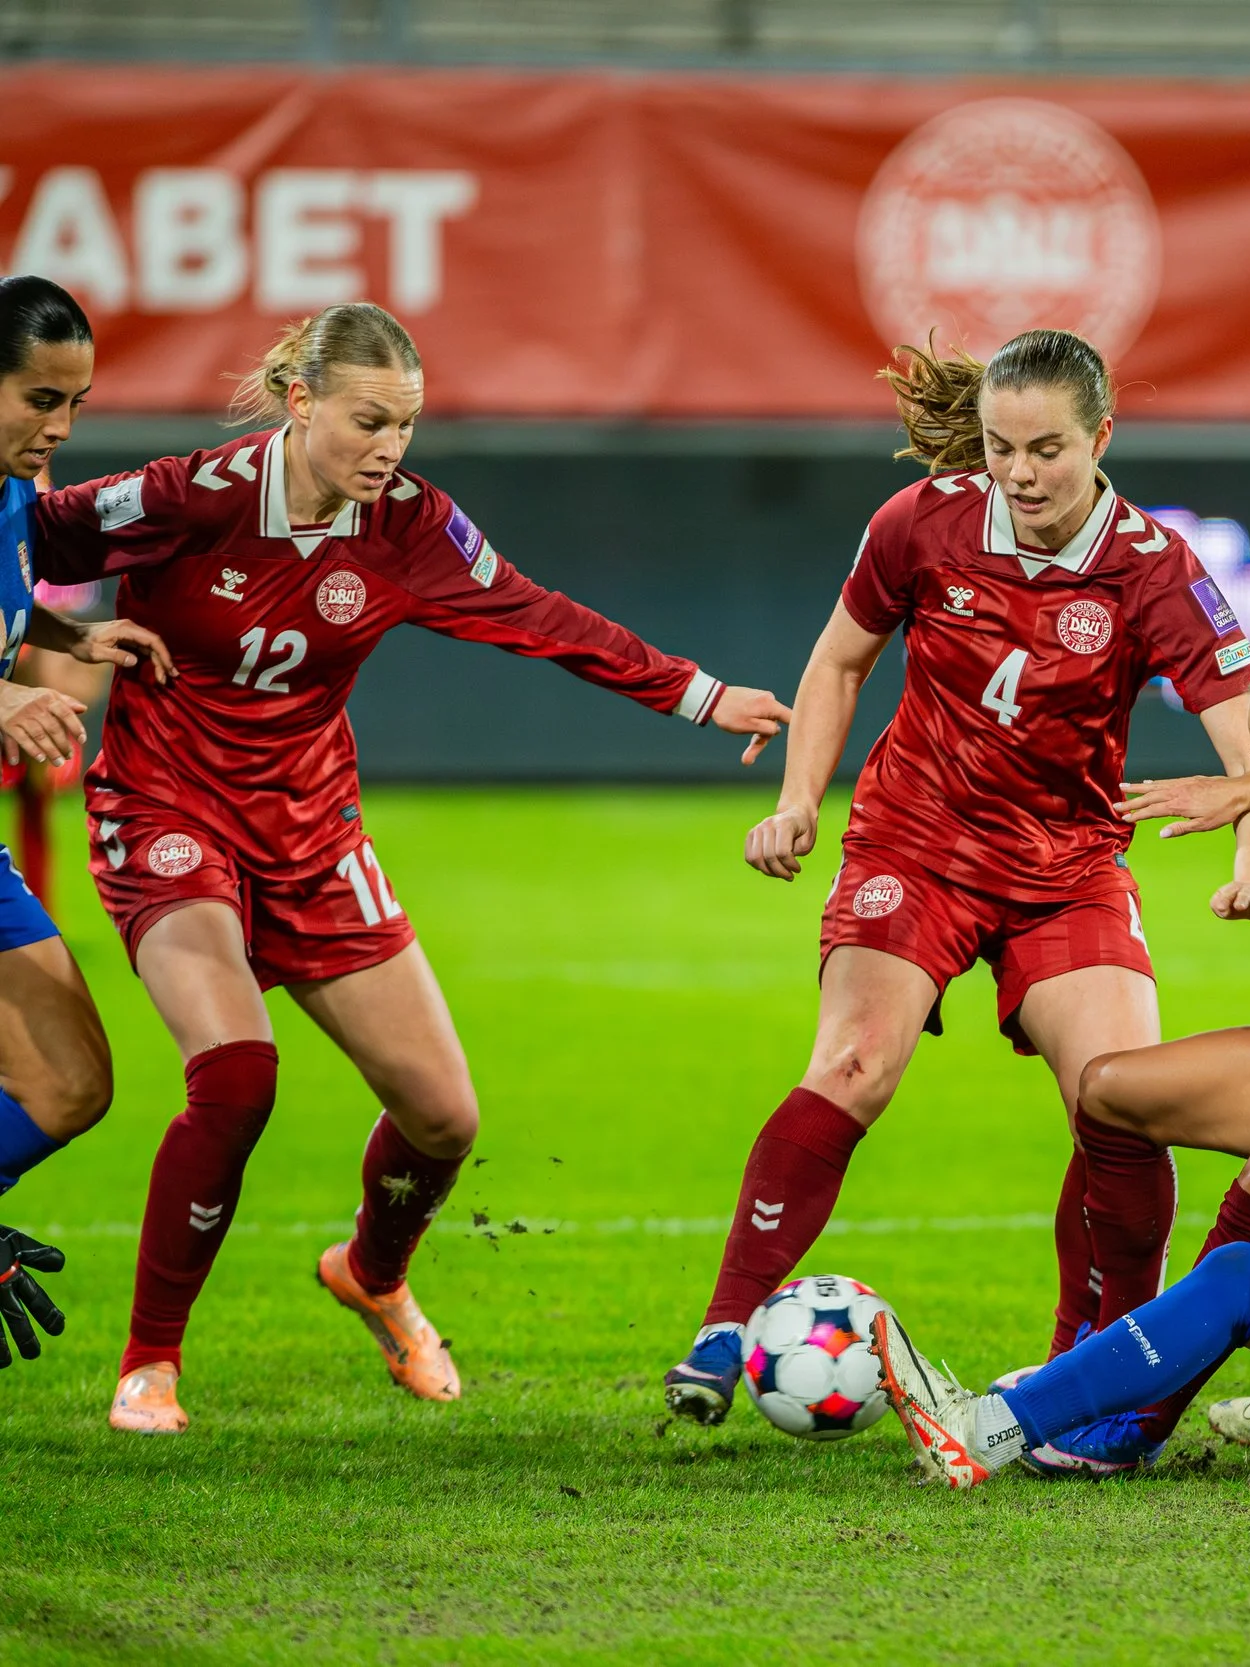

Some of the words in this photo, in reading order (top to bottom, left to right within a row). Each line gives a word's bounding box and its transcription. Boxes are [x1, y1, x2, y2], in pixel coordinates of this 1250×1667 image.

[0, 167, 478, 312] ABET
[327, 588, 356, 605] DBU
[943, 602, 974, 617] hummel
[1069, 616, 1101, 637] DBU
[232, 627, 307, 693] 12
[981, 648, 1029, 727] 4
[160, 846, 191, 863] DBU
[336, 841, 403, 926] 12
[862, 889, 892, 904] DBU
[988, 1425, 1022, 1448] SOCKS
